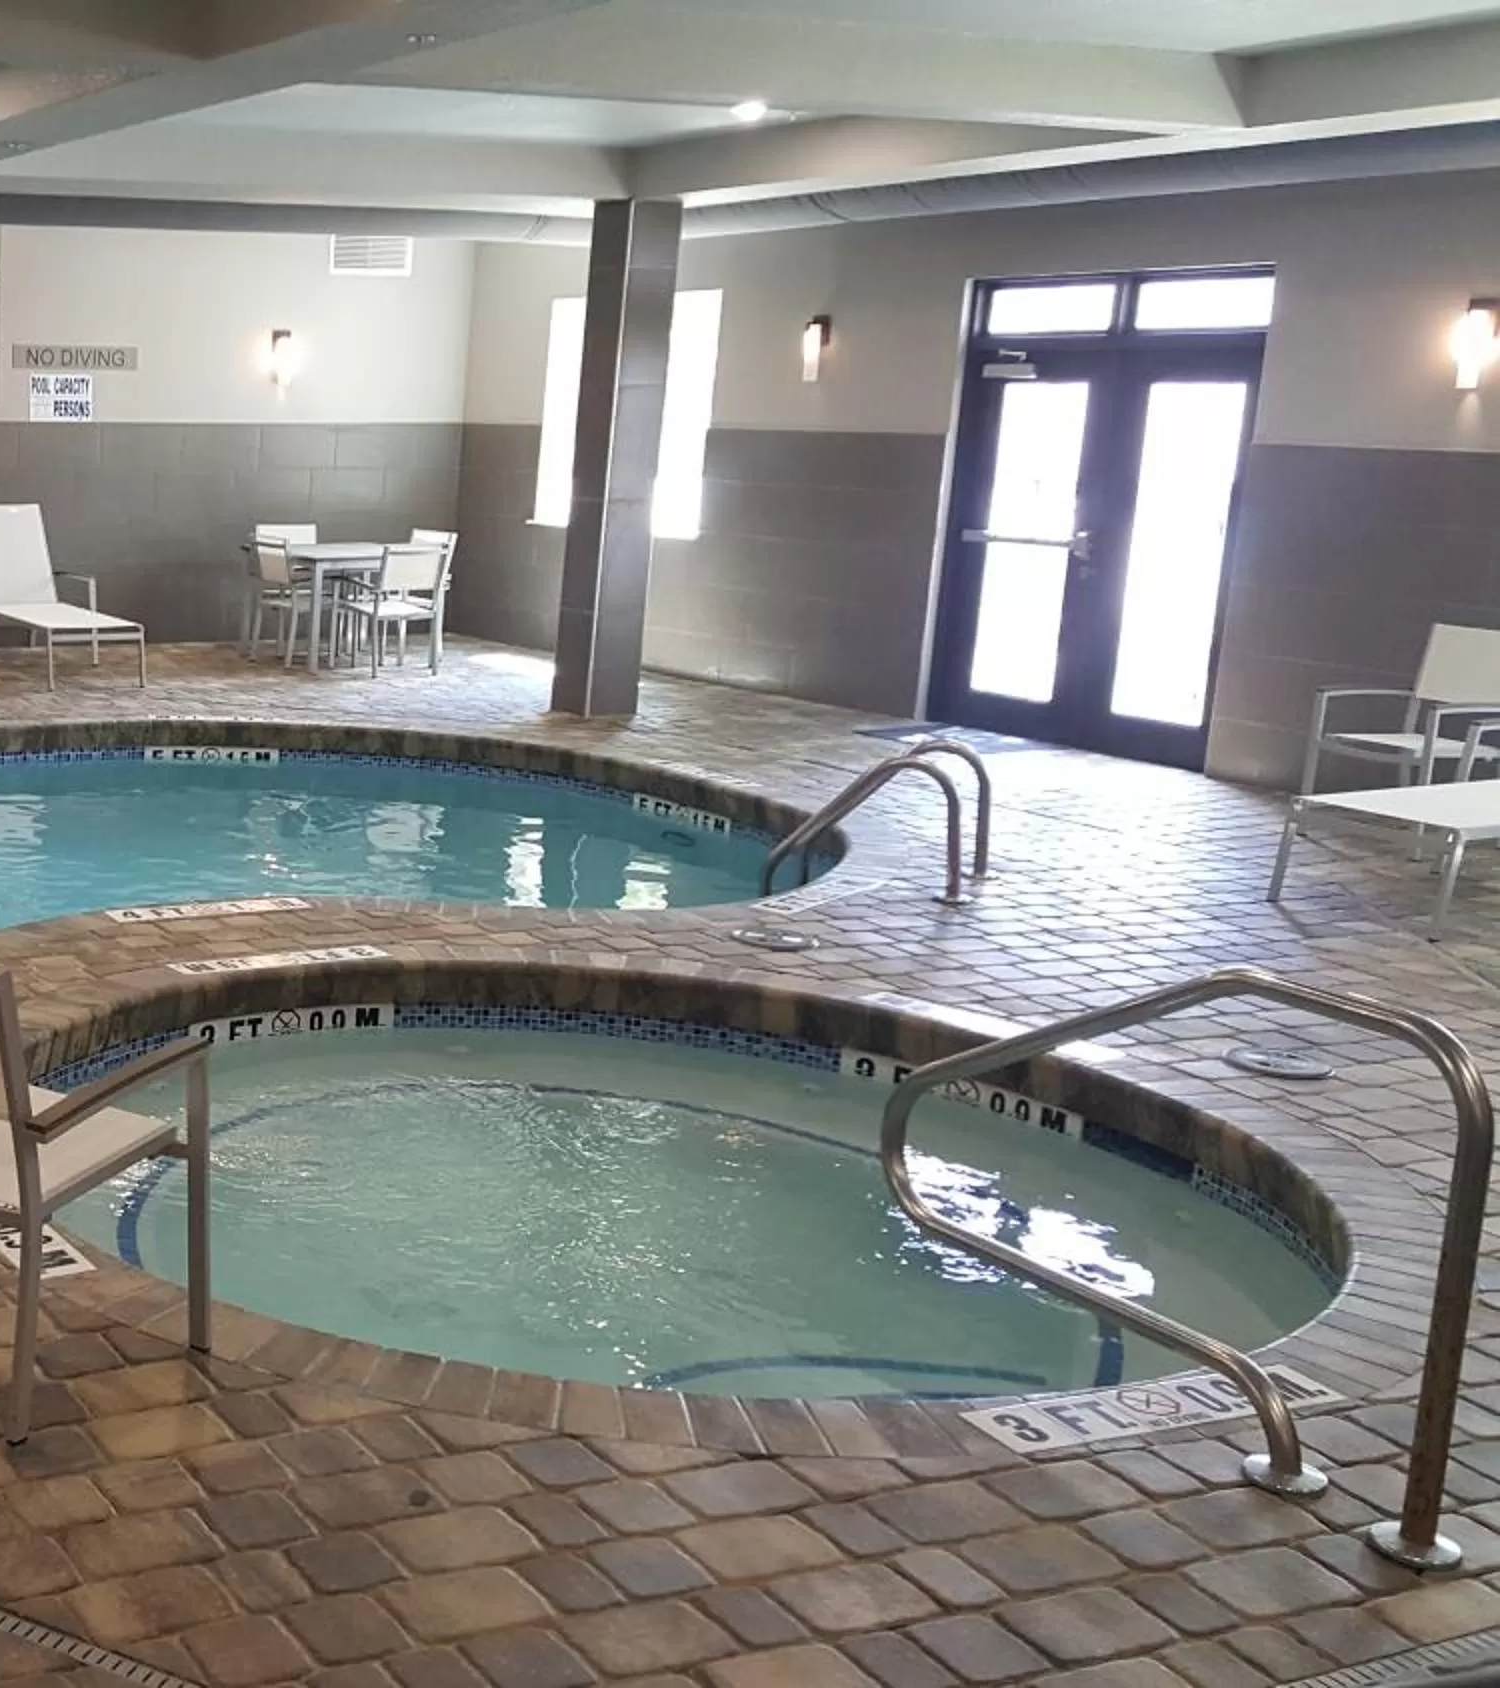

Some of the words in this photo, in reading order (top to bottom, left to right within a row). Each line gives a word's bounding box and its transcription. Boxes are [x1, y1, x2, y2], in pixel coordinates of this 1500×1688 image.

[25, 348, 55, 366] NO
[60, 349, 126, 368] DIVING
[31, 376, 51, 395] POOL
[53, 377, 90, 396] CAPACITY
[53, 400, 91, 418] PERSONS
[992, 1413, 1050, 1444] 3
